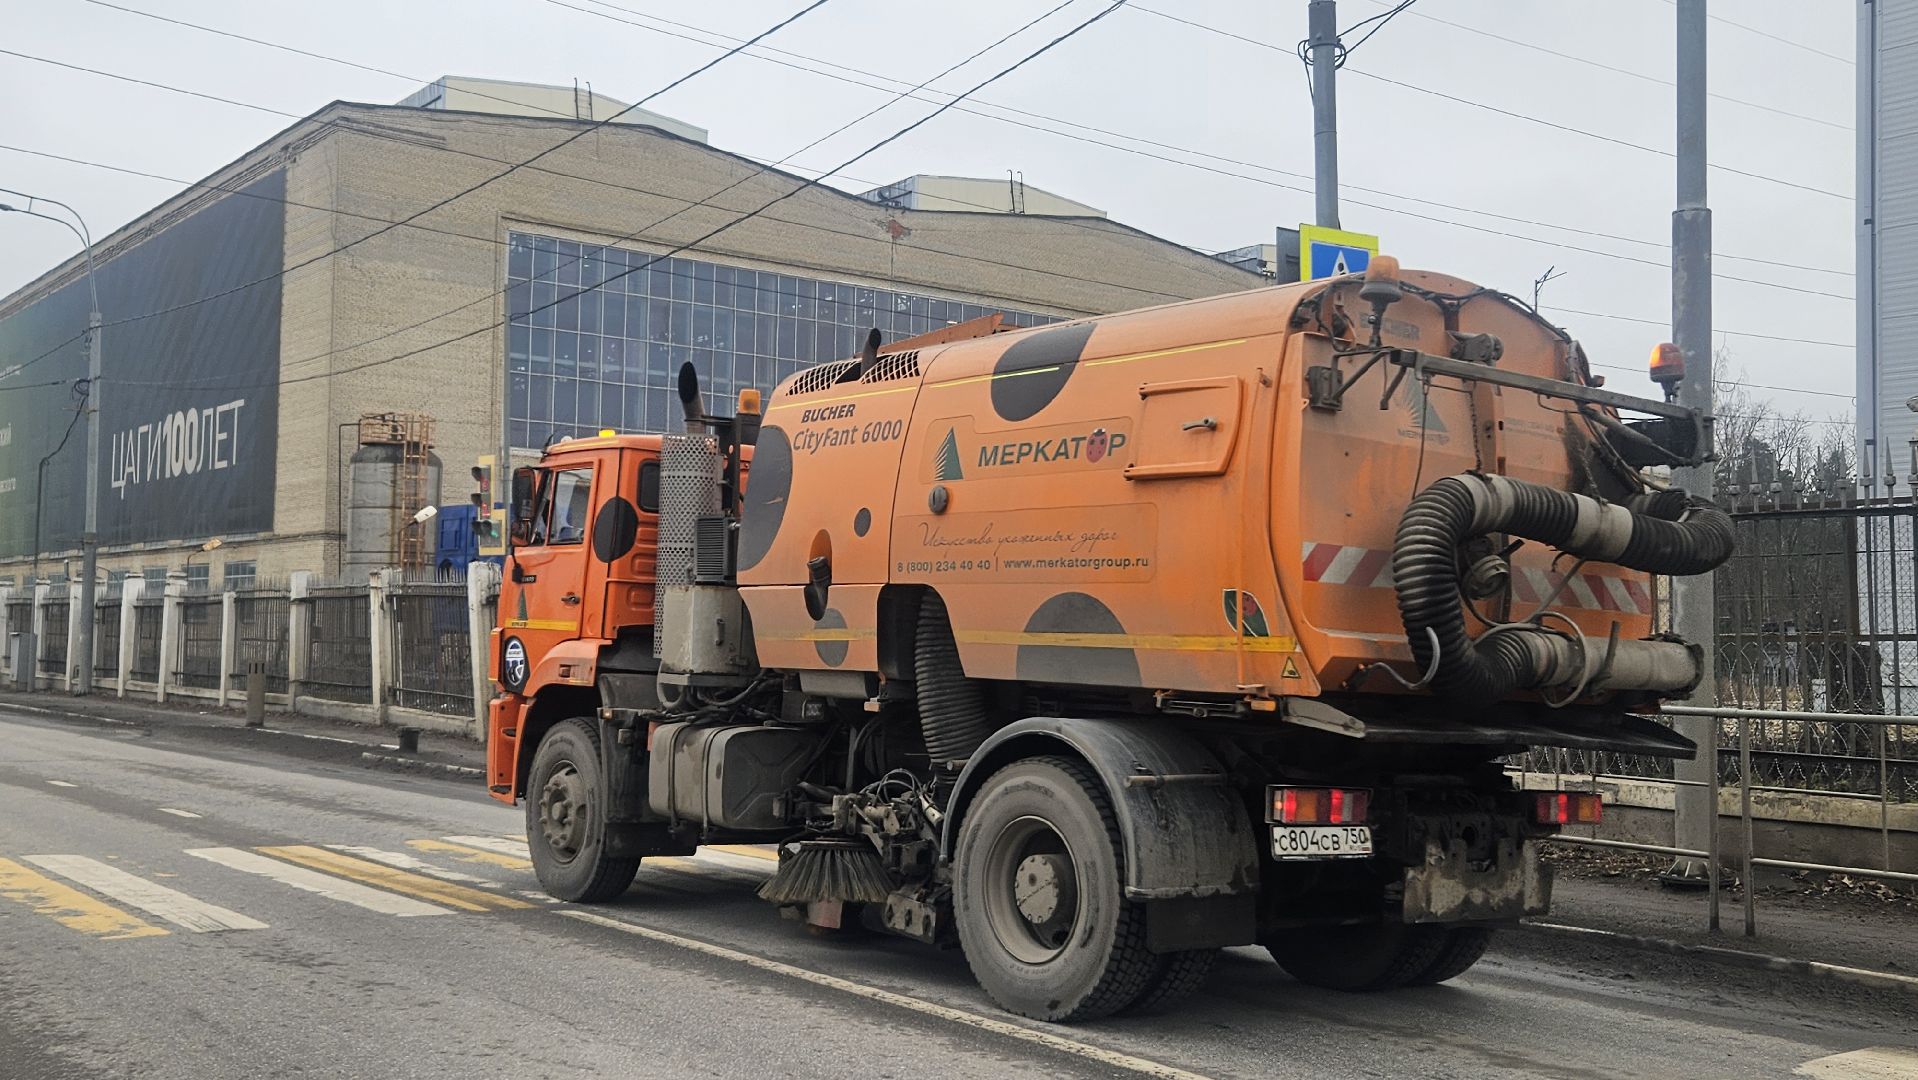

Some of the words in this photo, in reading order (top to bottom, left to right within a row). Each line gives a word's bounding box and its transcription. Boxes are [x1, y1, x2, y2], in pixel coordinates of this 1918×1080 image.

[801, 404, 856, 424] BUCHER
[793, 425, 859, 455] CityFant
[861, 419, 903, 444] 6000
[897, 562, 904, 572] 8
[906, 561, 933, 574] (800)
[935, 561, 957, 572] 234
[960, 560, 973, 570] 40
[977, 559, 991, 570] 40
[1003, 557, 1149, 570] www.merkatorgroup.ru
[1279, 829, 1341, 851] С804СВ
[1342, 828, 1367, 844] 750
